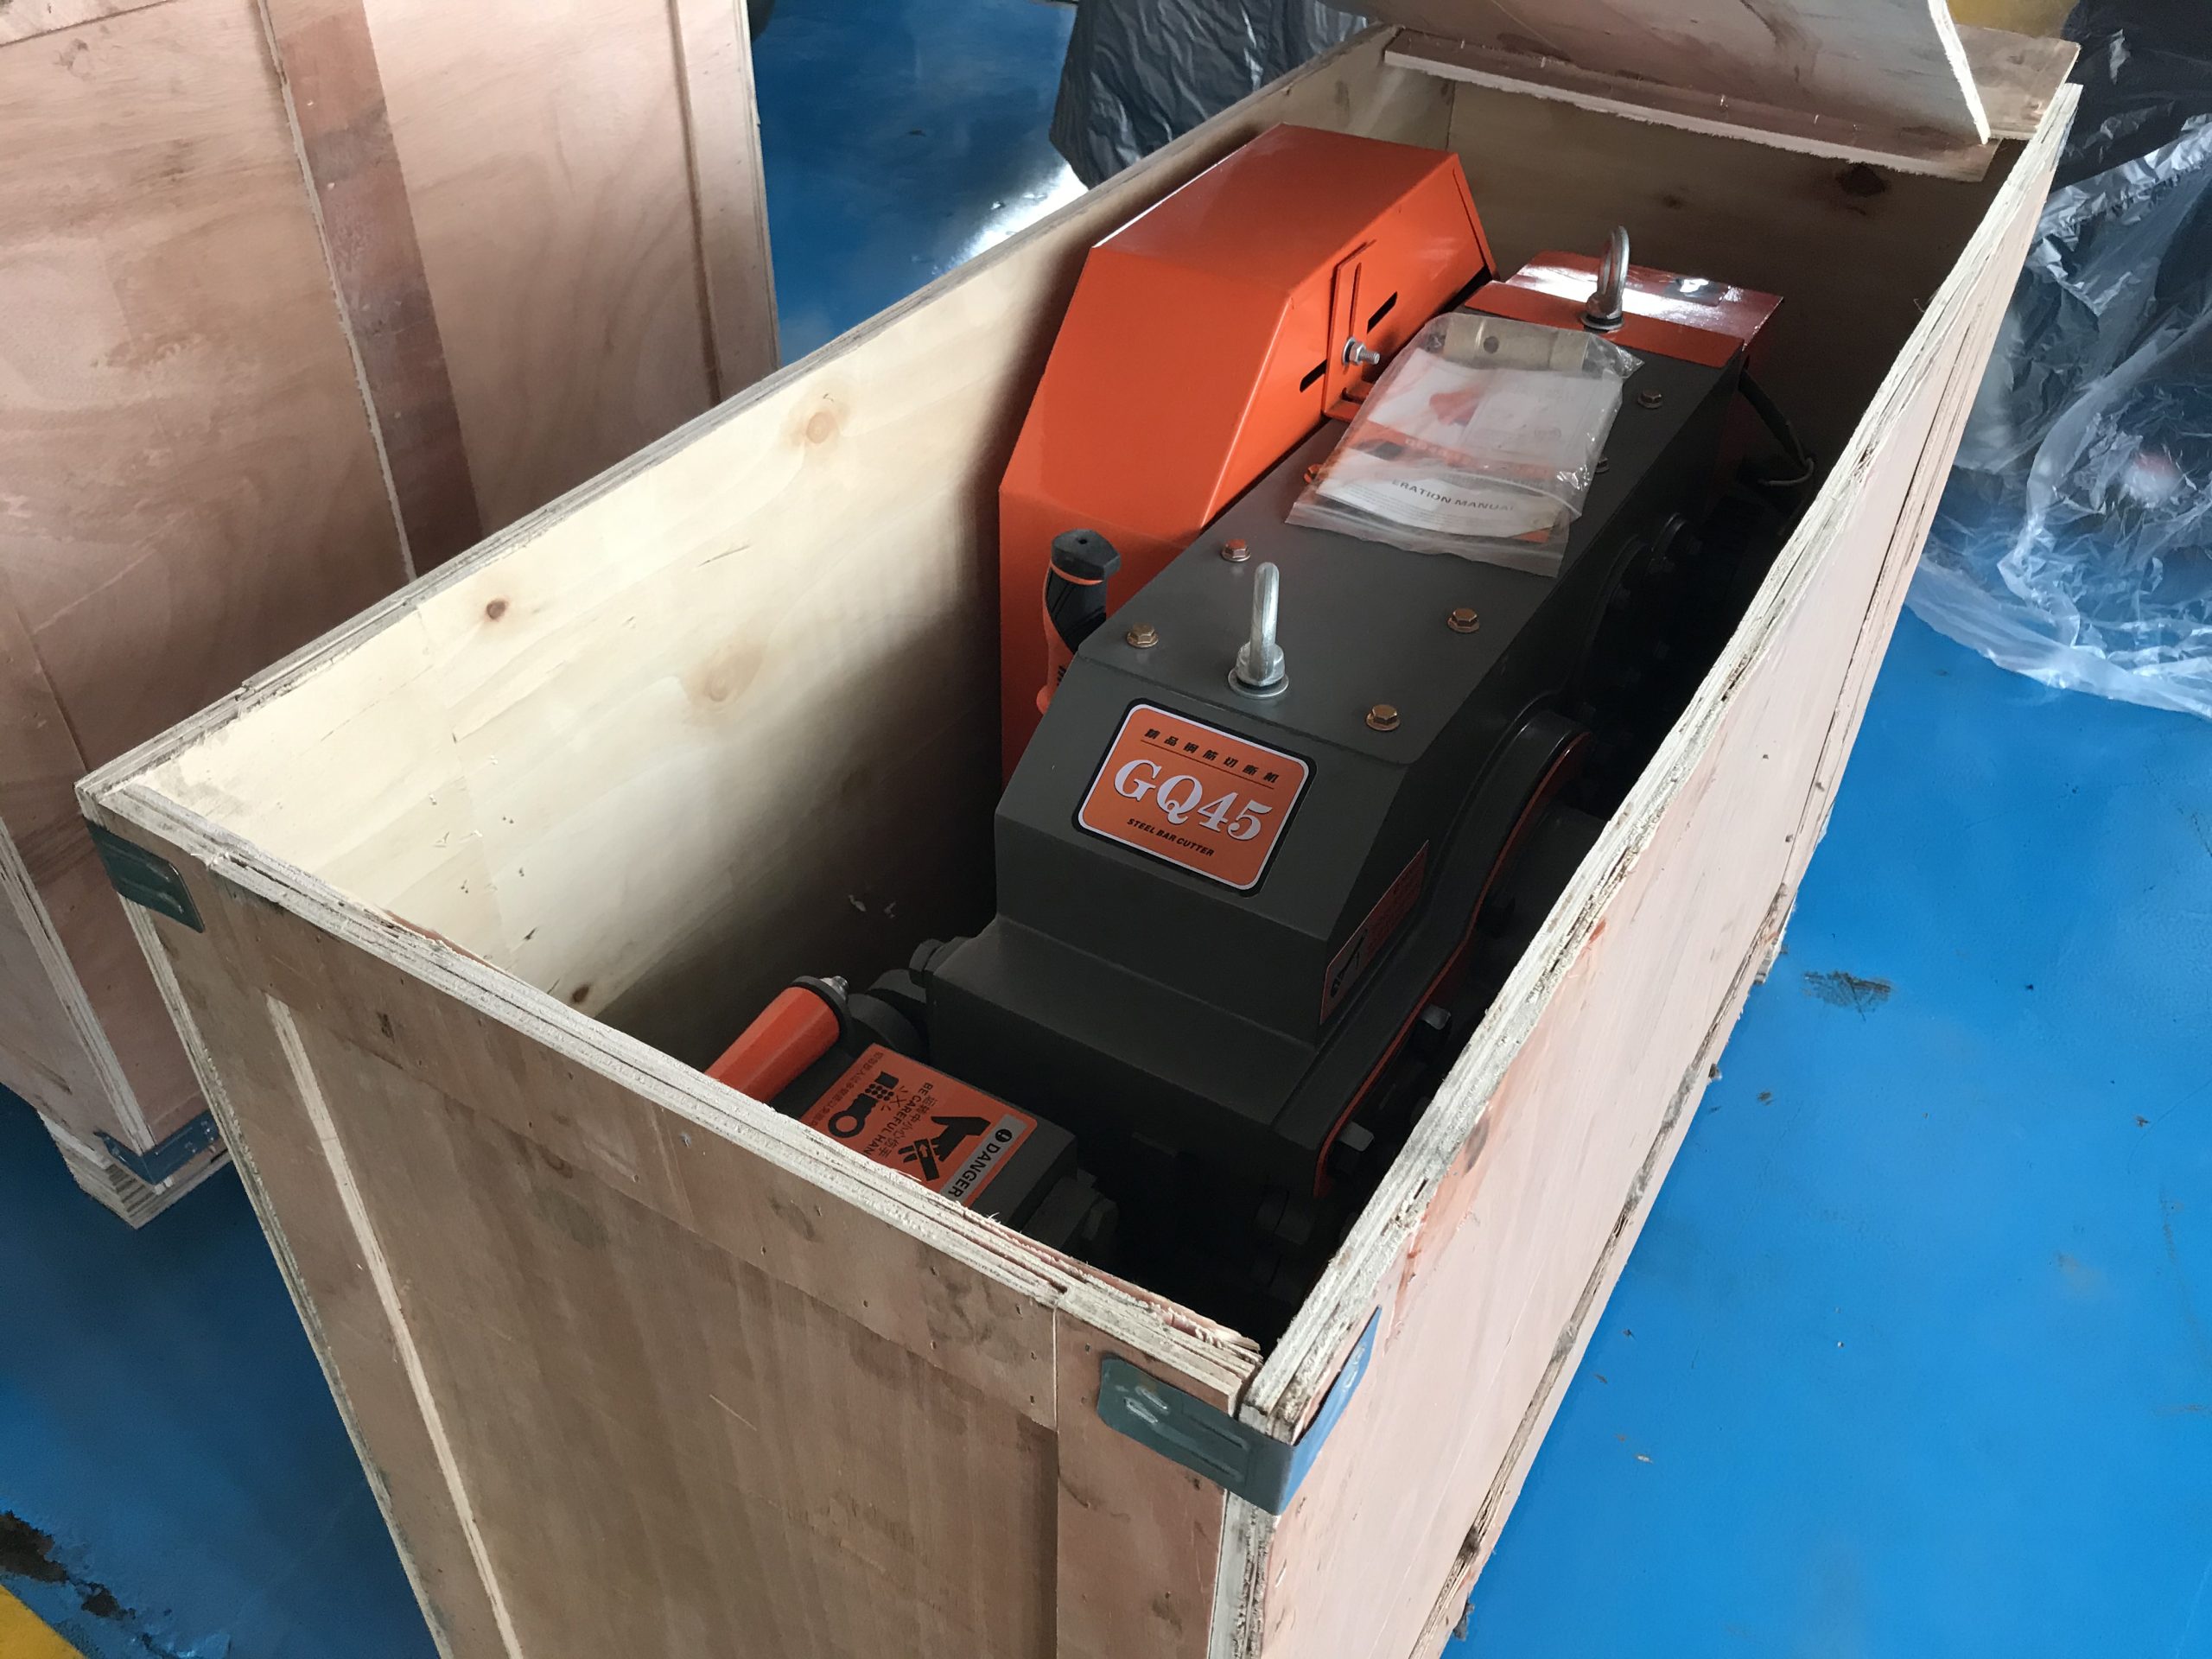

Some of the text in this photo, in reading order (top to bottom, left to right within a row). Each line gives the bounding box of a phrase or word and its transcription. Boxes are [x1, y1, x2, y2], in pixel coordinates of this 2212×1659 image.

[1114, 760, 1273, 841] GQ45
[1127, 818, 1215, 857] STEEL BAR CUTTER
[861, 1082, 933, 1156] BE CAREFUL HAN
[878, 1095, 938, 1159] 运转中小心伤手
[948, 1143, 1000, 1198] DANGER
